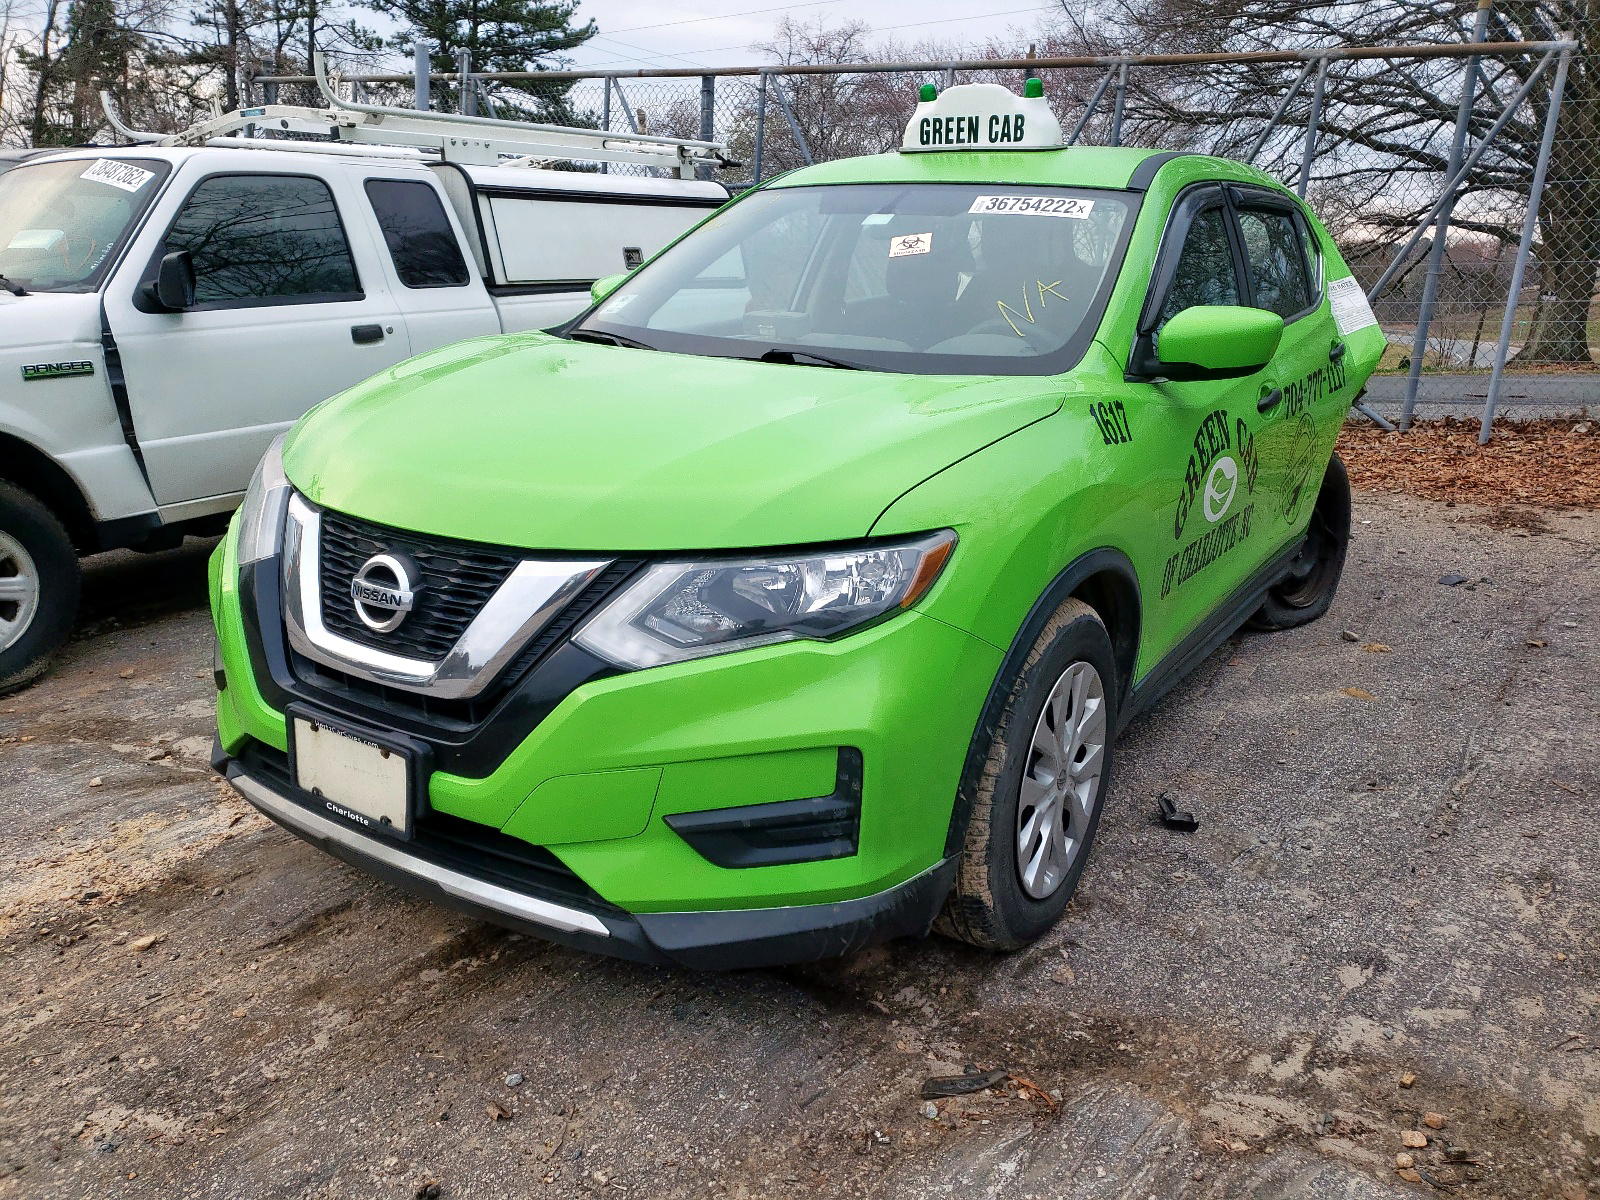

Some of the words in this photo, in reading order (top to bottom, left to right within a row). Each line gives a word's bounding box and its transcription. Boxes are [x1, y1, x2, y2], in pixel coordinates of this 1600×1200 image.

[919, 115, 980, 146] GREEN
[988, 113, 1026, 144] CAB
[22, 360, 94, 374] RANGER
[1089, 399, 1133, 446] 1617
[1174, 409, 1231, 541] GREEN
[352, 584, 402, 607] NISSAN
[326, 802, 369, 826] Charlotte
